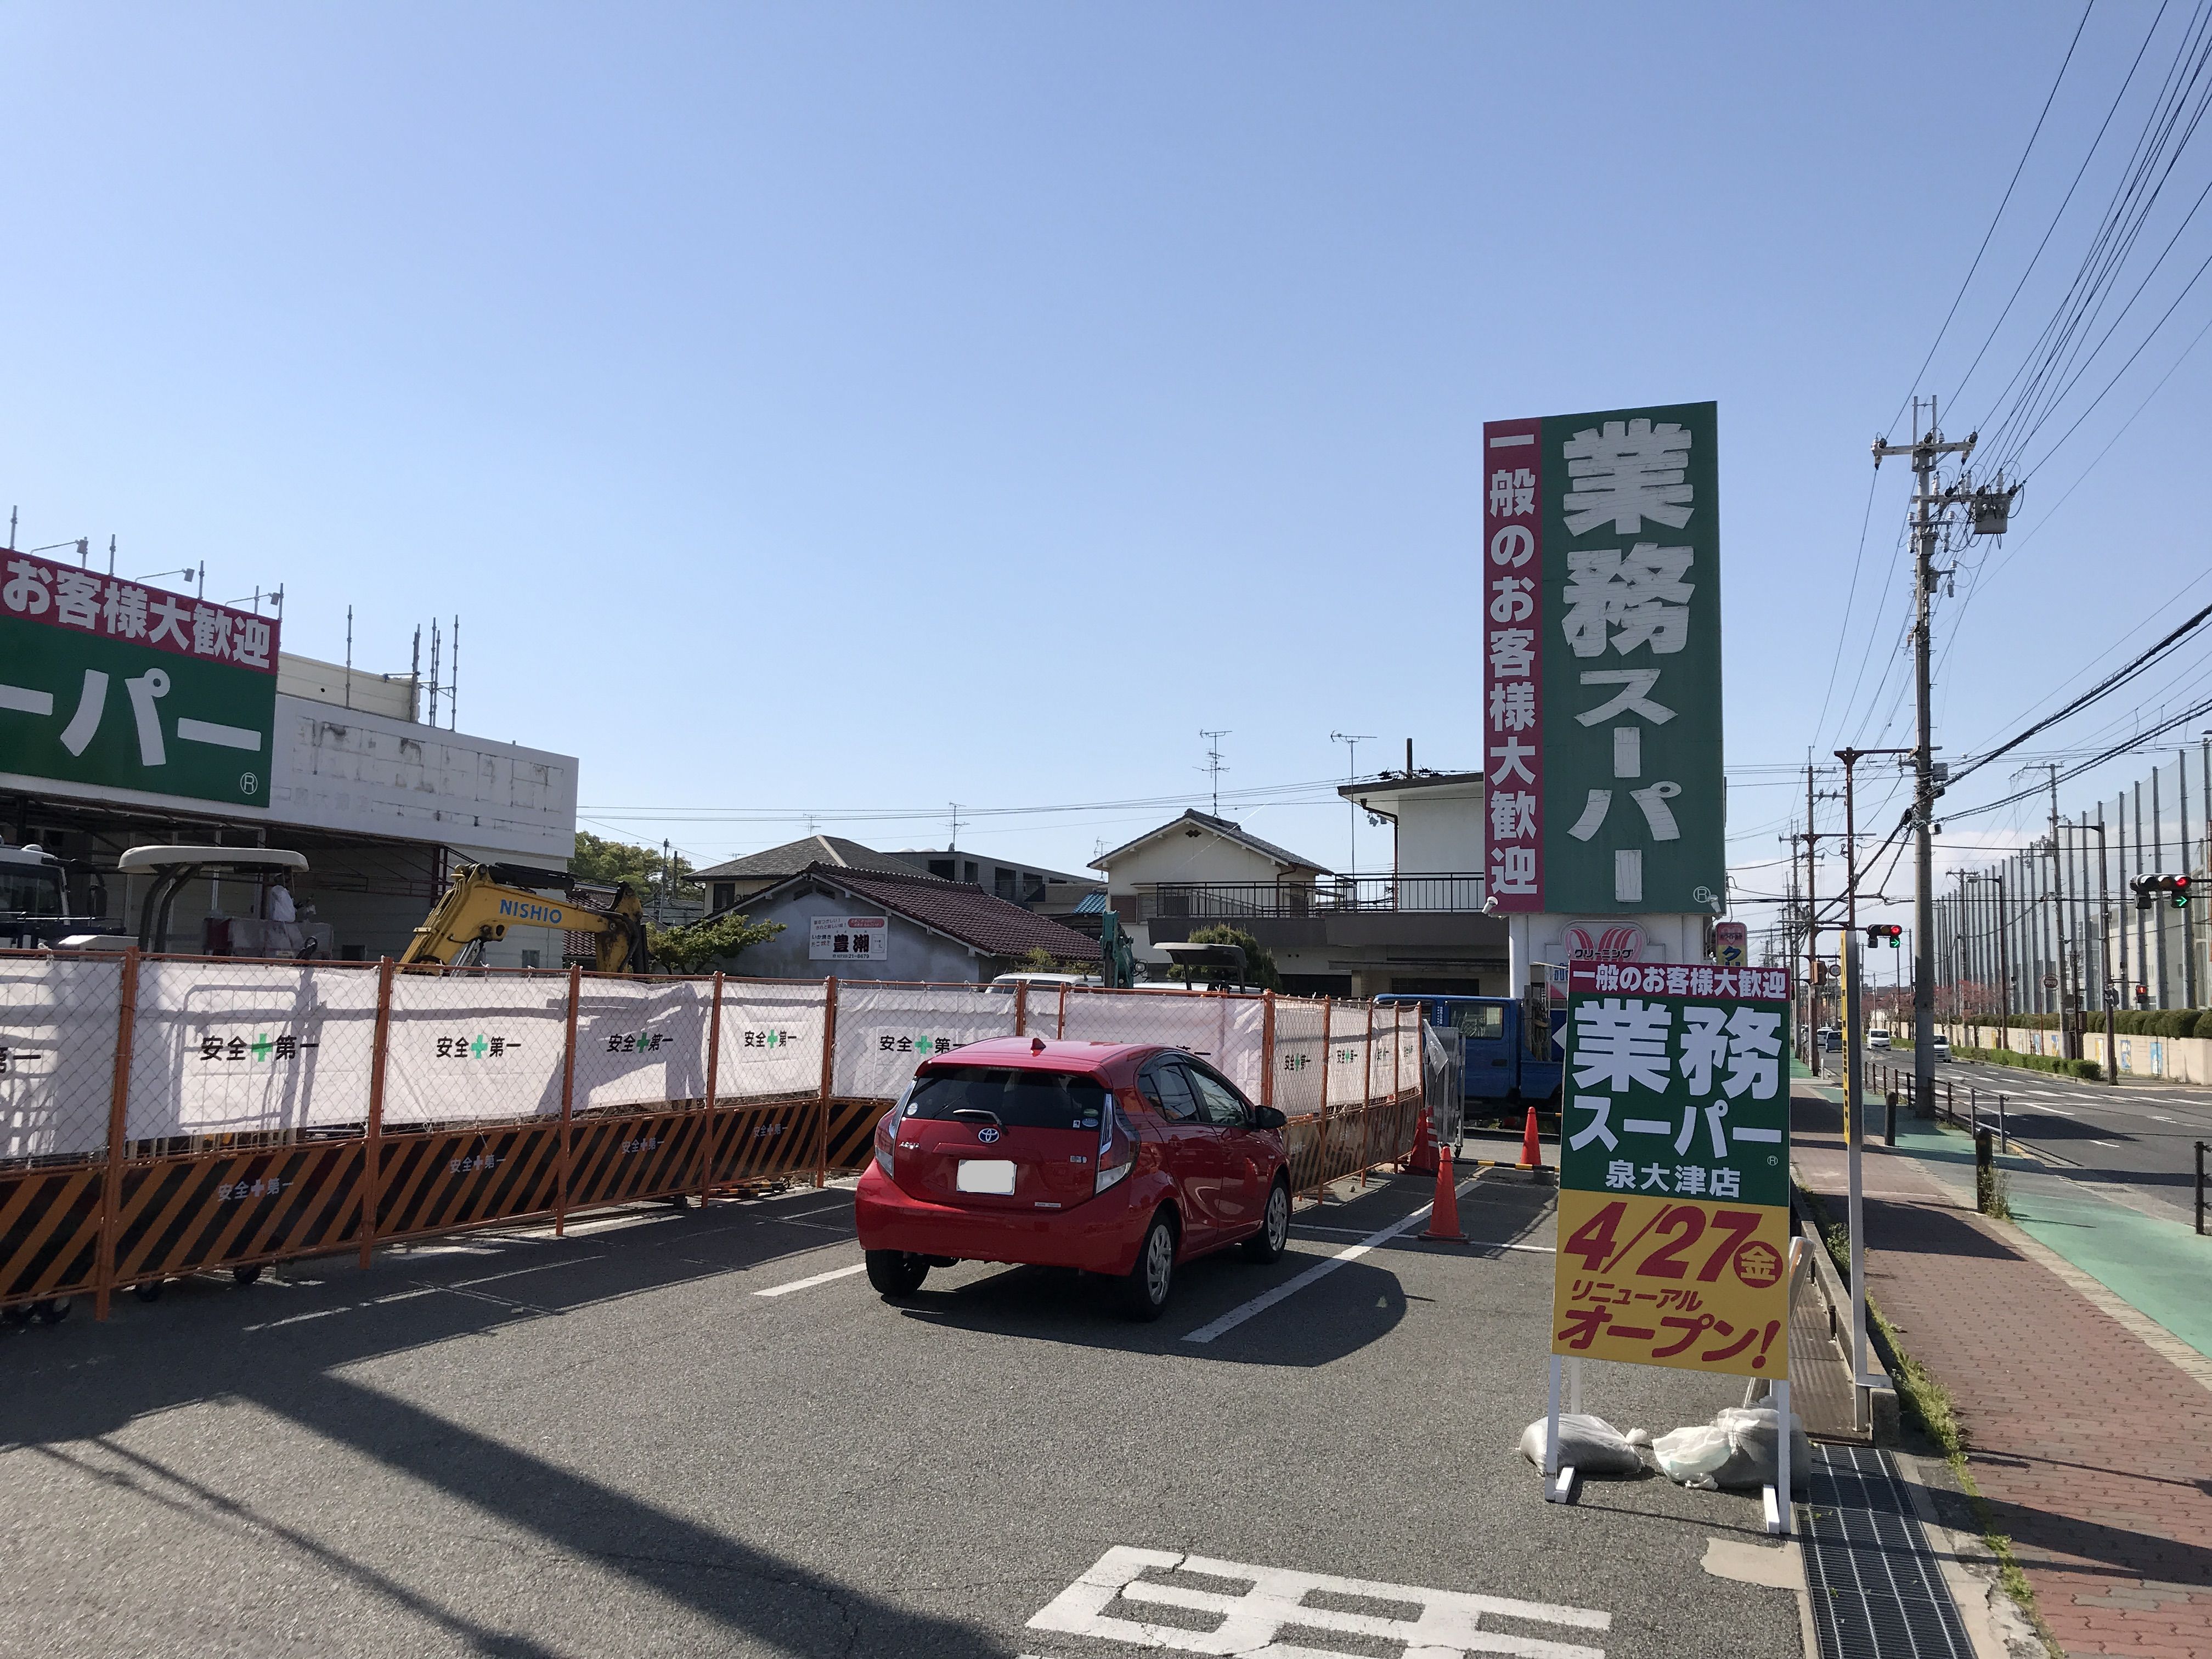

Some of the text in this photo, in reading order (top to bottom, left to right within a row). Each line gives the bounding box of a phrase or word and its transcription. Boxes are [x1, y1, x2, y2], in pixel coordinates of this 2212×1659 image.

[3, 558, 270, 669] お客様大歓迎
[1489, 434, 1538, 895] 一般のお客様大歓迎
[499, 898, 562, 924] NISHIO
[1573, 963, 1786, 999] 一般のお客様大歓迎
[1574, 948, 1634, 959] クリーニング
[1572, 998, 1783, 1099] 業務
[1569, 1095, 1782, 1159] スーパー
[1605, 1159, 1741, 1198] 泉大津店
[1564, 1201, 1763, 1283] 4/27
[1571, 1279, 1703, 1312] リニューアル
[1558, 1305, 1781, 1369] オープン!
